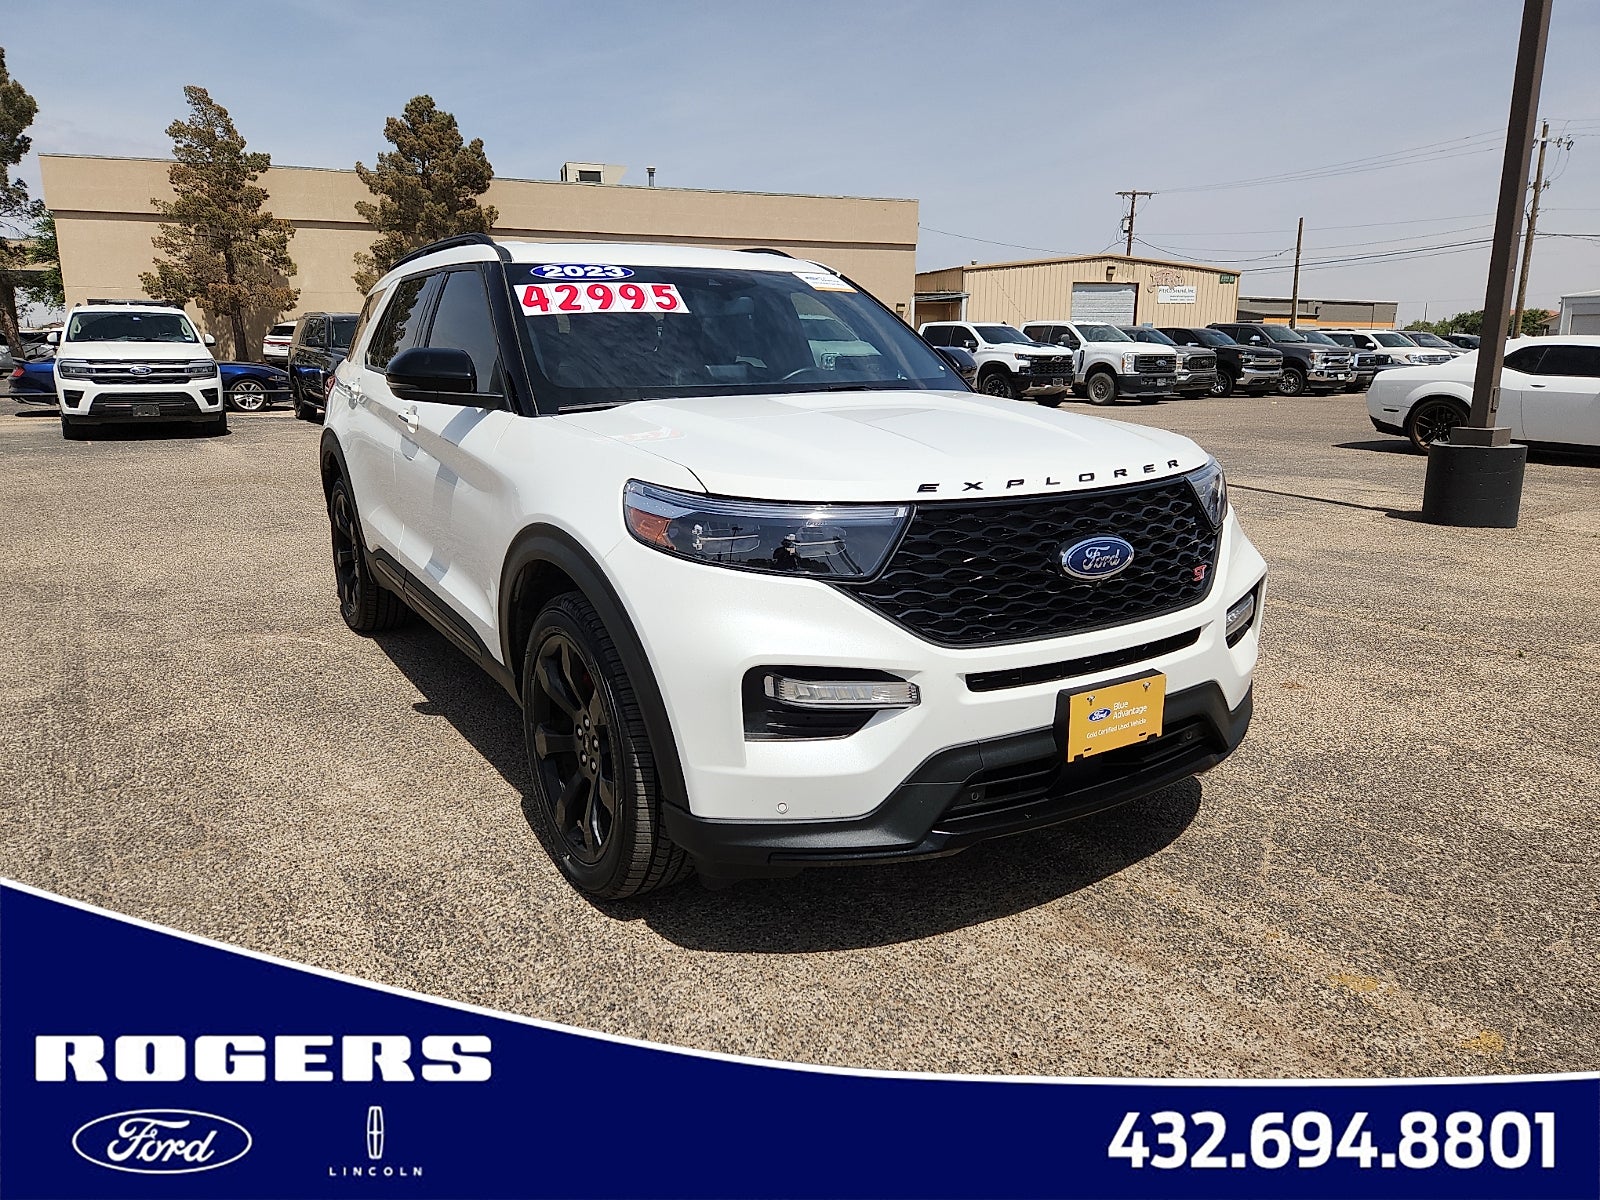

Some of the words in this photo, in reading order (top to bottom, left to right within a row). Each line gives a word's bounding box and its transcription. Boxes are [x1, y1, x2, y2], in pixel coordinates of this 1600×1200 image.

[542, 265, 626, 277] 2023
[522, 284, 678, 312] 42995
[917, 459, 1180, 493] EXPLORER
[1083, 546, 1120, 570] Ford
[1193, 564, 1206, 581] ST
[1113, 702, 1128, 710] Blue
[1113, 705, 1147, 719] Advantage
[1090, 709, 1110, 721] Ford
